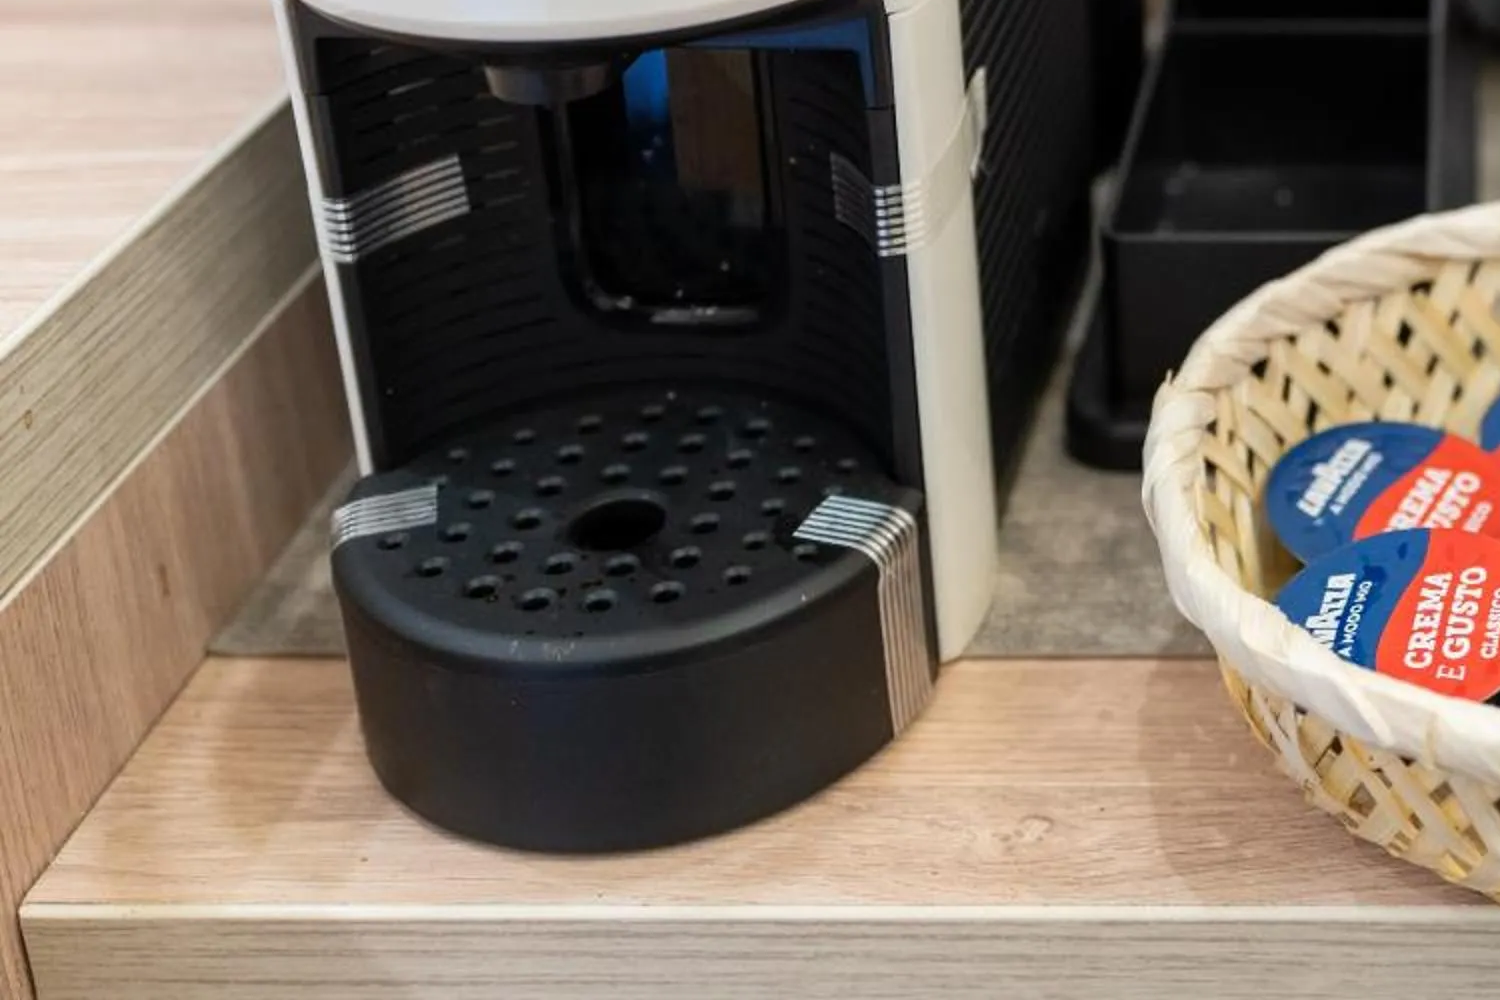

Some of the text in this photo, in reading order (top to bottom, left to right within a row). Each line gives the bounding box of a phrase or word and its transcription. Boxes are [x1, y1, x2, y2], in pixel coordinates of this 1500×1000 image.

[1296, 438, 1373, 518] LAVAZZA
[1337, 580, 1373, 658] A MODO MIO
[1403, 572, 1453, 670] CREMA
[1441, 566, 1488, 660] GUSTO
[1435, 664, 1468, 682] E
